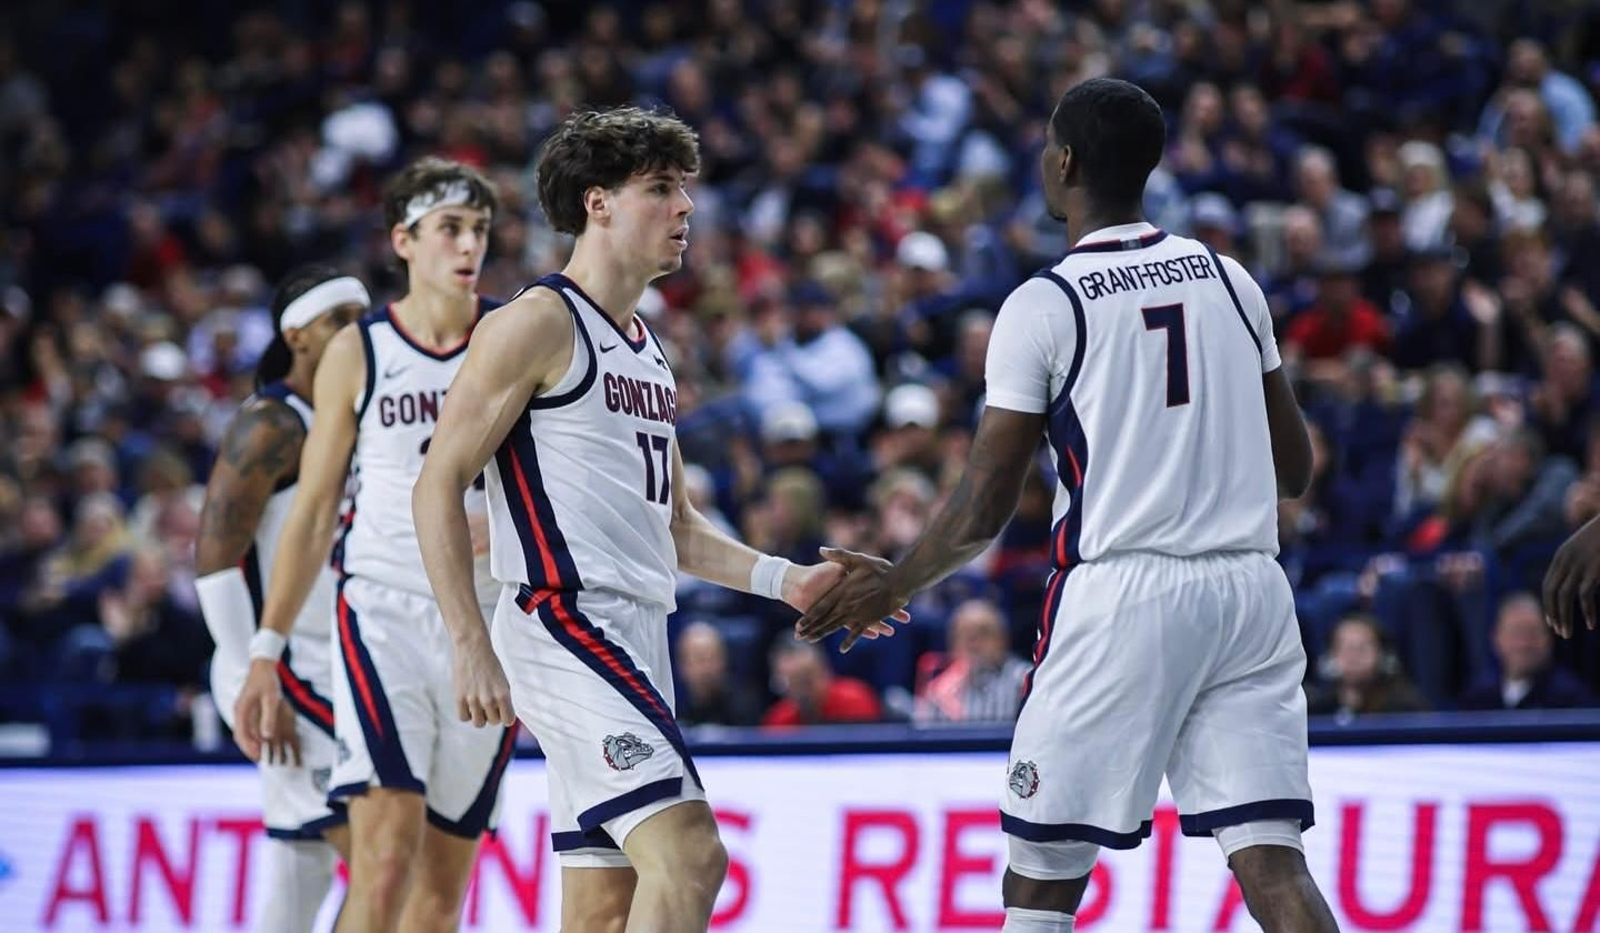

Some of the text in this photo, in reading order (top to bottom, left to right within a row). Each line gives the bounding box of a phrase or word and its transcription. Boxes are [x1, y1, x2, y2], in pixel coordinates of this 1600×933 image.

[1078, 254, 1216, 300] GRANT-FOSTER
[1141, 302, 1190, 408] 7
[380, 390, 447, 427] GON
[603, 371, 676, 427] GONZAG
[636, 431, 670, 504] 17
